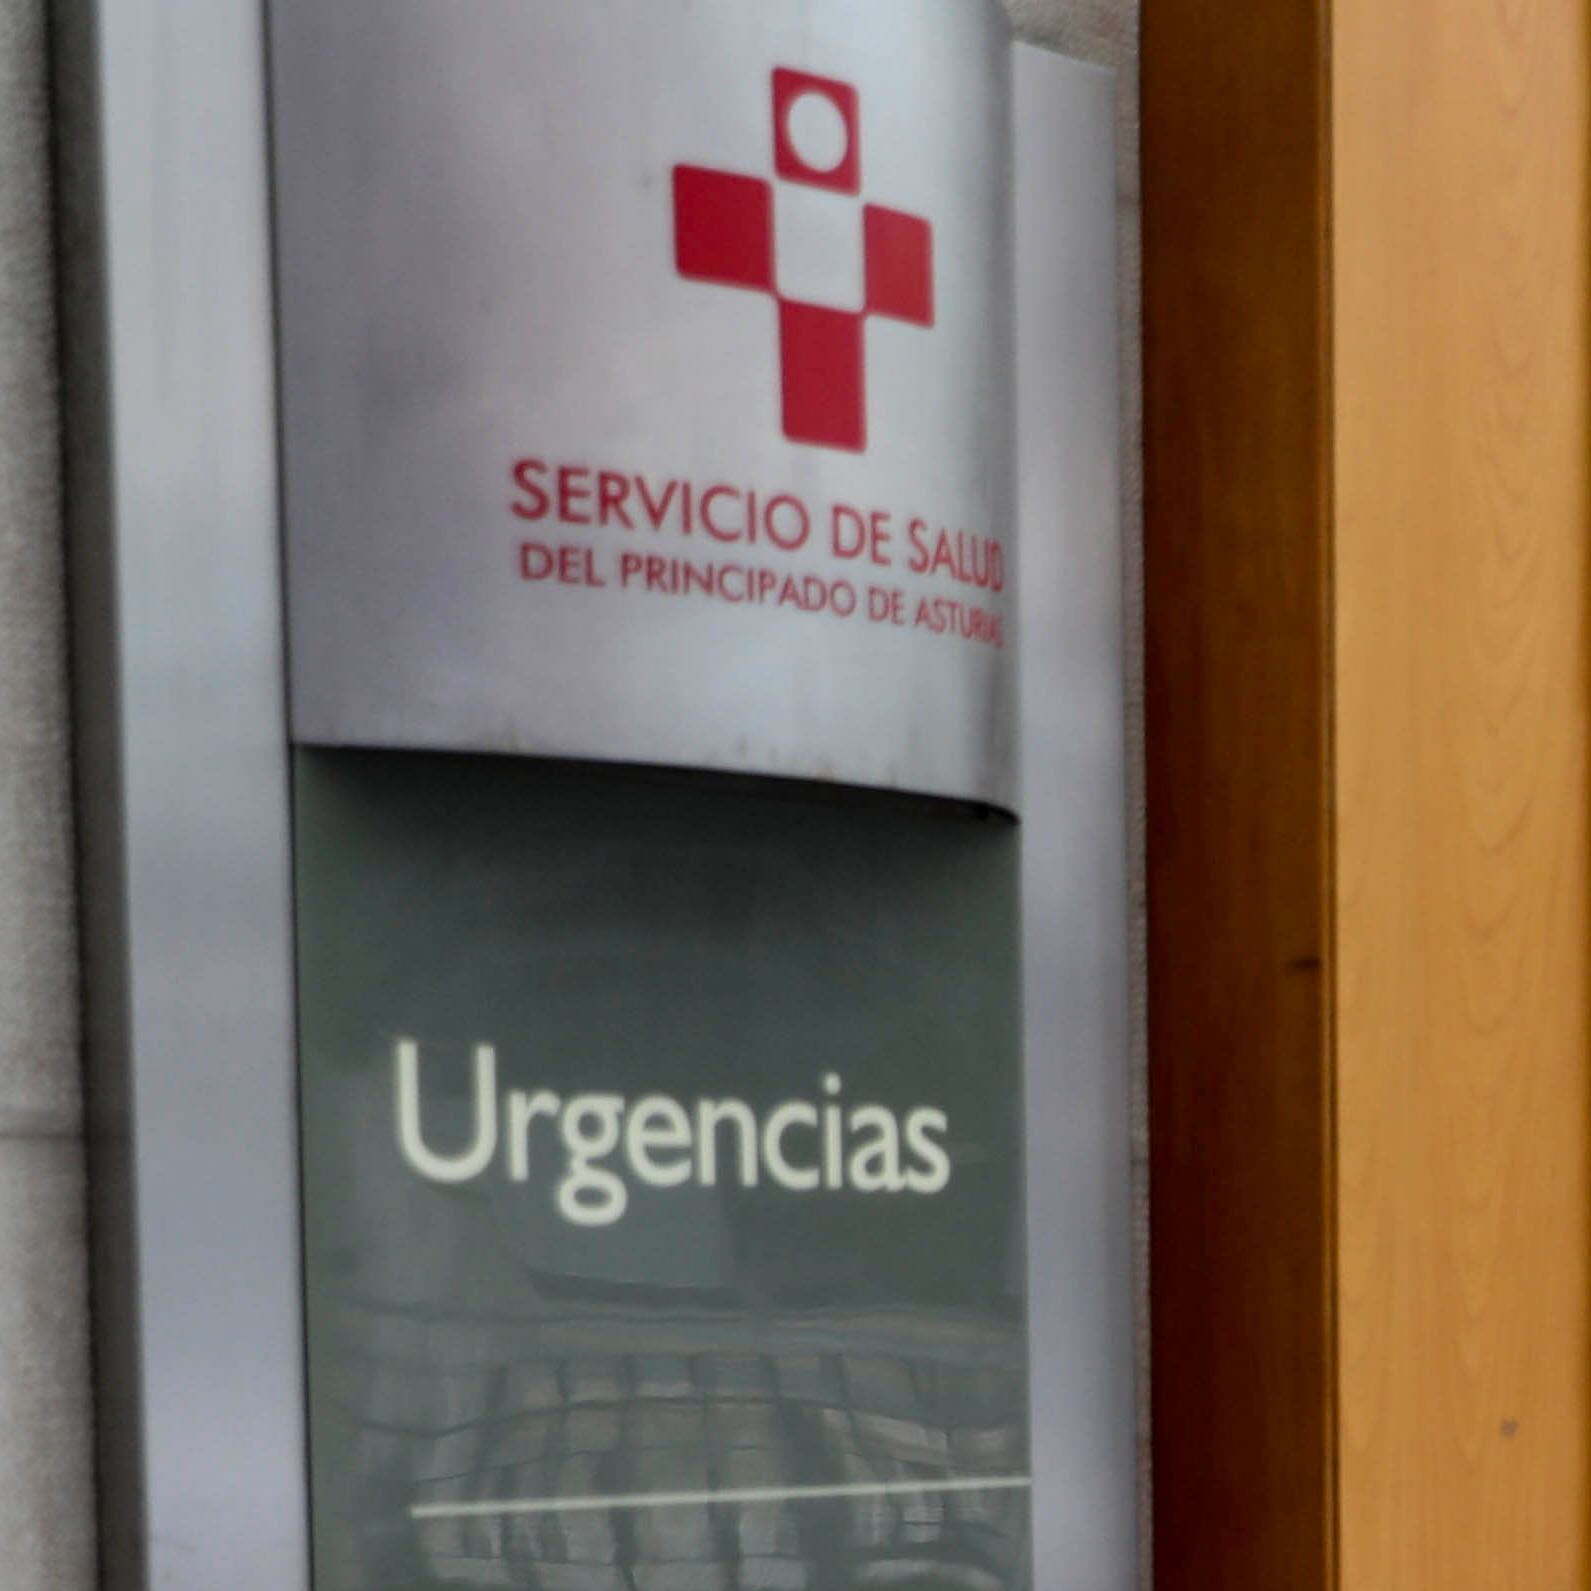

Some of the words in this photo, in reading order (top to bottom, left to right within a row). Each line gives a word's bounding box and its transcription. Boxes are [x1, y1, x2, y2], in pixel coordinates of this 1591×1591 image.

[511, 457, 812, 550] SERVICIO
[832, 502, 894, 567] DE
[907, 516, 1004, 593] SALUD
[519, 541, 605, 588] DEL
[620, 551, 857, 618] PRINCIPADO
[868, 584, 904, 626] DE
[398, 1036, 952, 1226] Urgencias
